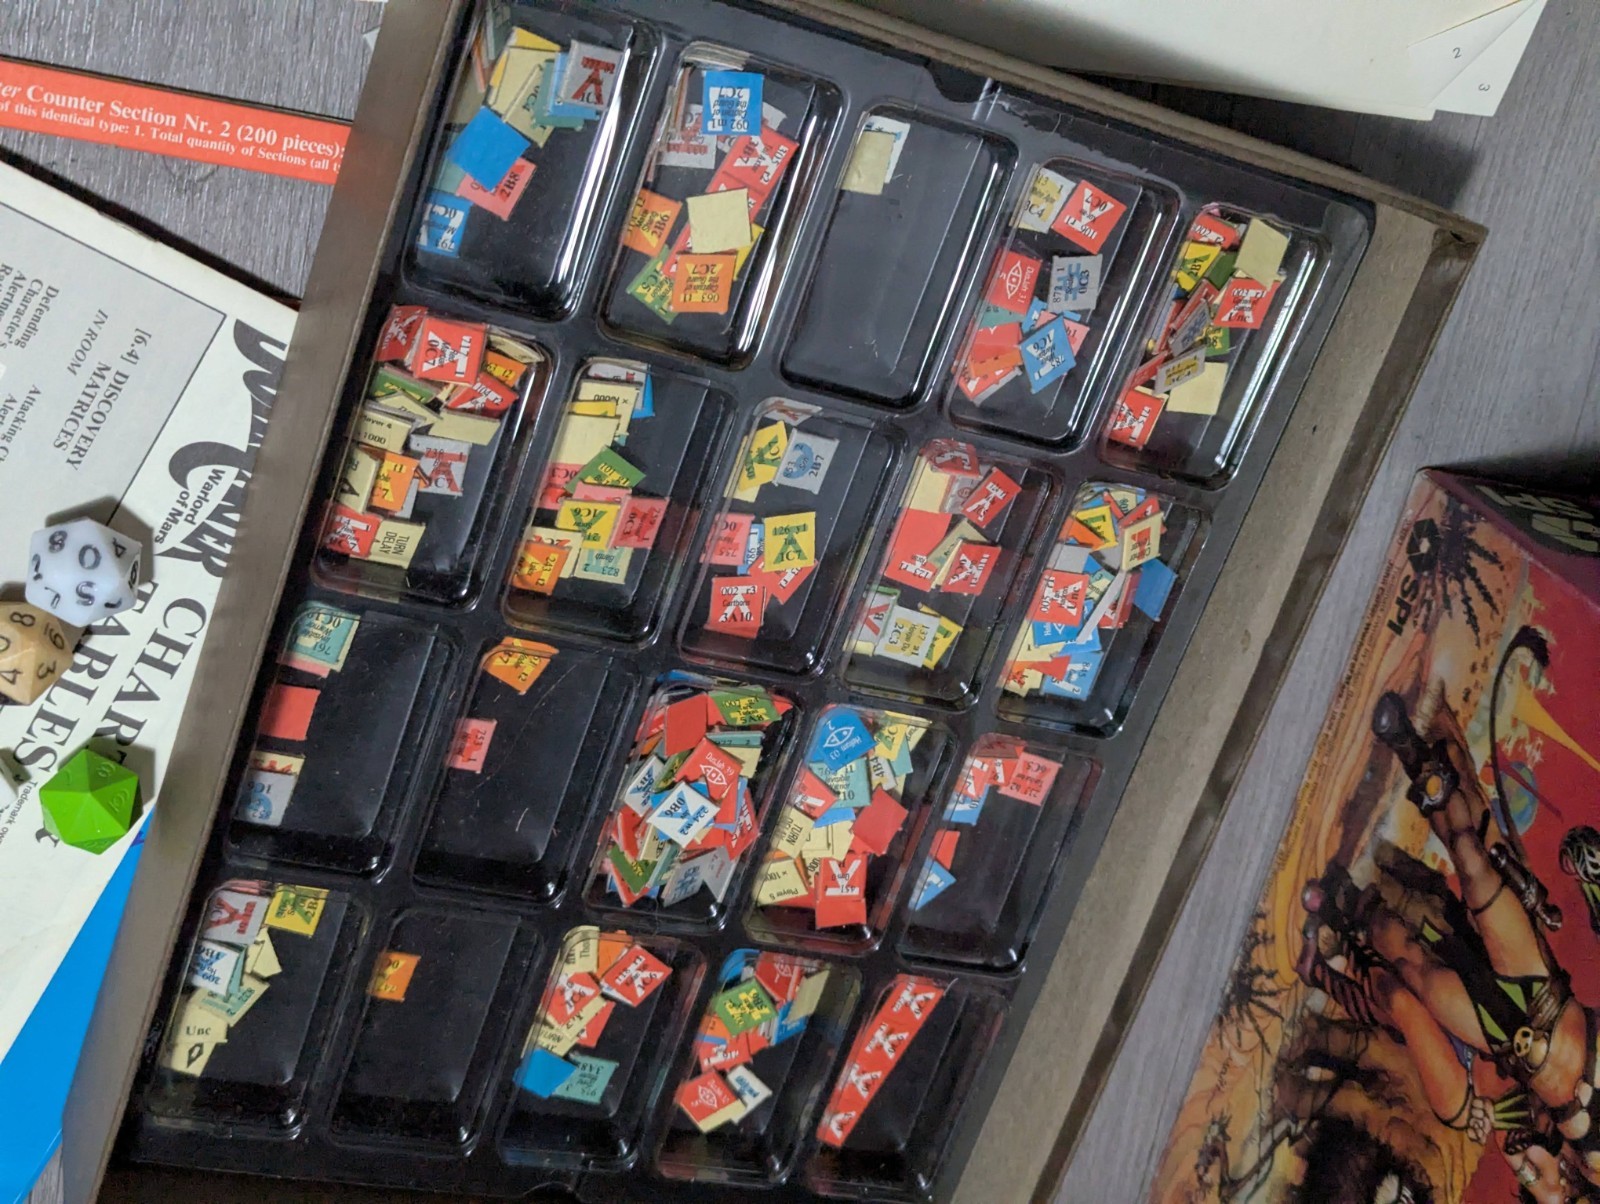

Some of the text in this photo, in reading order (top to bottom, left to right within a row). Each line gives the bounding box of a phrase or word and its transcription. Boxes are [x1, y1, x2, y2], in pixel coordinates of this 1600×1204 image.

[1452, 47, 1462, 59] 2
[718, 86, 741, 97] 2C7
[1478, 83, 1490, 92] 3
[0, 82, 345, 158] er Counter Section Nr. 2 (200 pieces):
[730, 119, 748, 128] 092
[15, 103, 37, 117] this
[41, 107, 95, 128] identical
[99, 119, 129, 134] type:
[134, 124, 145, 137] 1.
[150, 127, 183, 143] Total
[186, 136, 236, 155] quantity
[241, 145, 254, 156] of
[257, 147, 307, 166] Sections
[310, 157, 330, 170] (all
[771, 145, 787, 166] 305
[499, 170, 520, 197] 2B8
[1083, 191, 1108, 212] 0C7
[651, 212, 670, 238] 2B6
[692, 263, 716, 273] 2C7
[1188, 255, 1204, 277] 2B7
[685, 274, 706, 283] Guard
[693, 283, 718, 292] Captain
[1078, 269, 1089, 294] 0C3
[701, 293, 719, 302] 063
[17, 285, 59, 349] Defending
[1227, 312, 1251, 322] Unc
[67, 308, 109, 377] IN ROOM
[424, 339, 438, 365] 0C7
[53, 362, 112, 452] MATRICES
[66, 328, 152, 471] [6.4] DISCOVERY
[1, 384, 43, 441] Attacking
[808, 453, 825, 477] 2B7
[184, 468, 226, 525] Warlord
[154, 489, 190, 545] of Mars
[574, 507, 597, 517] 1C6
[623, 511, 636, 536] 0C3
[378, 530, 397, 555] DELAY
[391, 533, 409, 556] TURN
[541, 555, 555, 573] 243
[745, 546, 755, 564] 786
[780, 551, 801, 561] 1C7
[601, 566, 619, 576] 823
[721, 585, 755, 594] 002 r3
[1067, 586, 1080, 610] Unc
[1038, 593, 1051, 613] 005
[1387, 575, 1420, 637] SPI
[720, 612, 751, 622] 3A10
[887, 621, 904, 646] 2C3
[916, 623, 929, 641] 137
[312, 641, 332, 655] 761
[473, 728, 485, 746] 753
[839, 735, 862, 751] Helium
[5, 780, 38, 825] Trademark
[663, 795, 686, 818] 0B6
[690, 805, 709, 824] 224
[784, 823, 803, 845] TURN
[775, 885, 798, 898] Player
[186, 1025, 211, 1035] Unc
